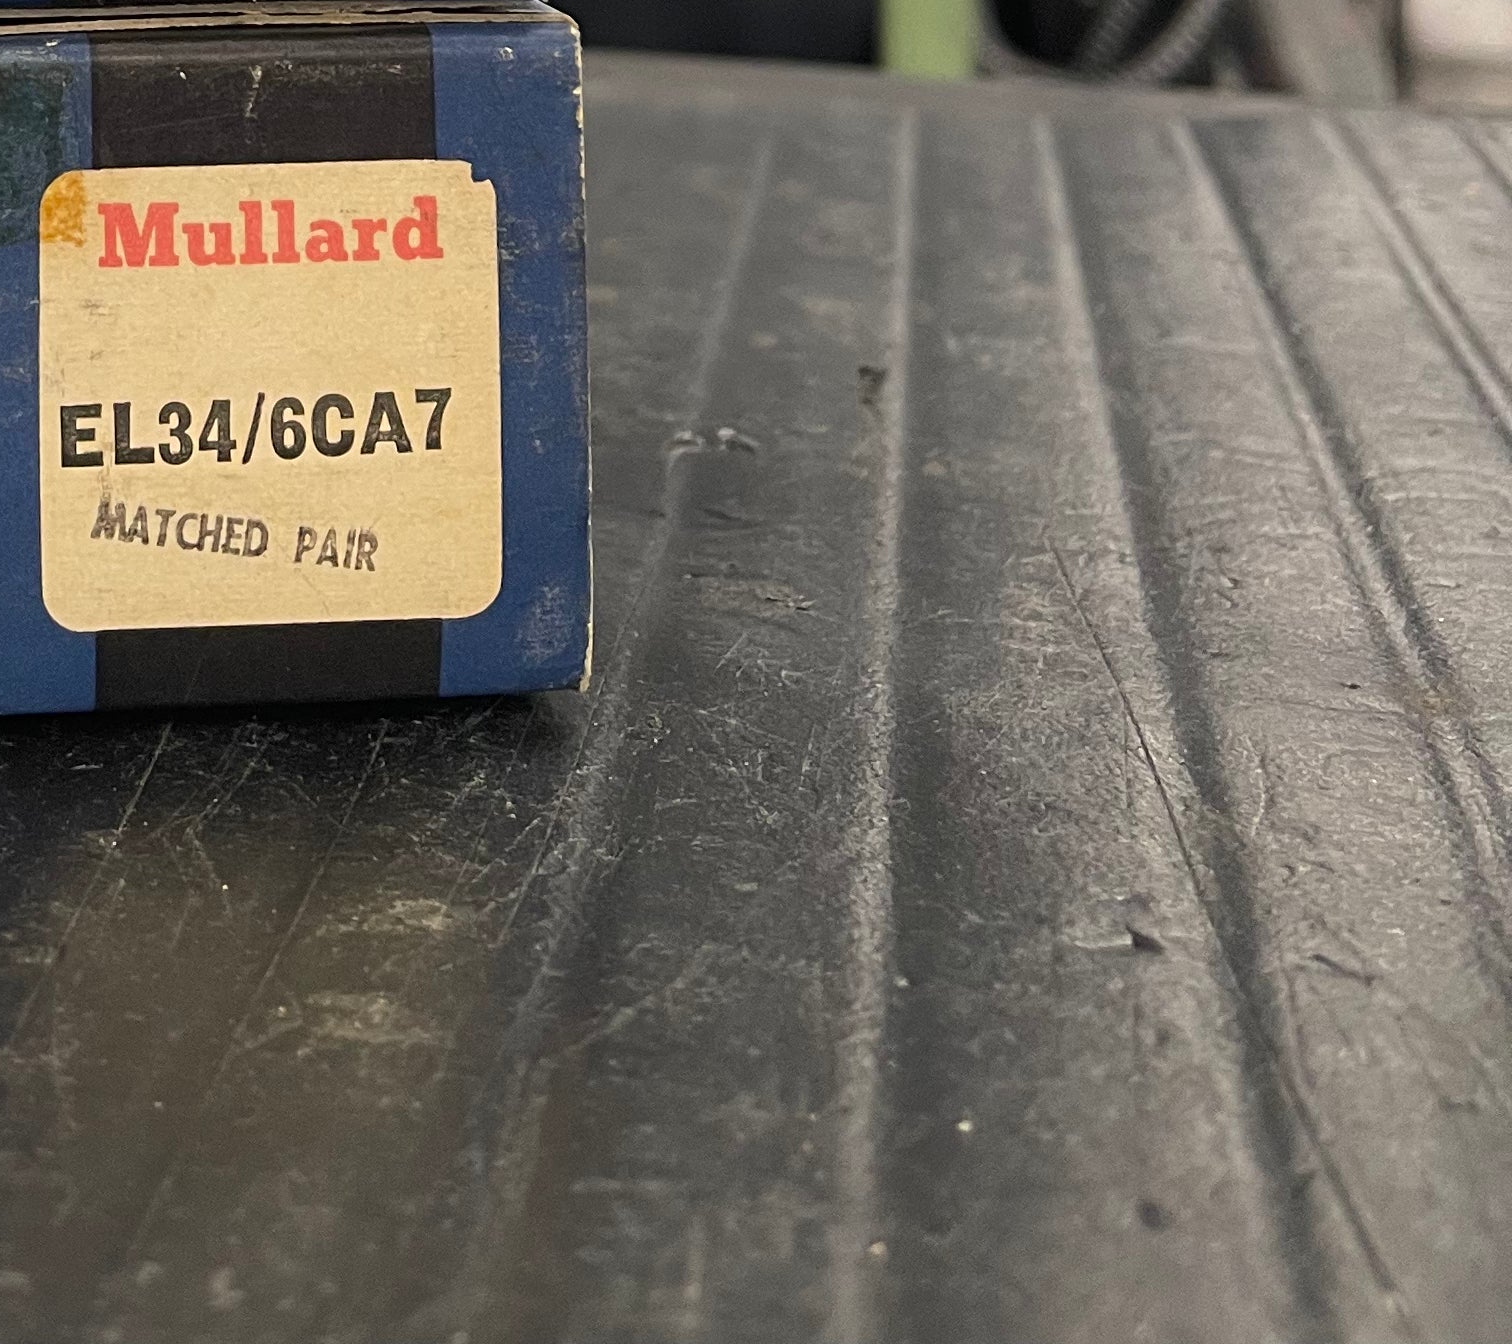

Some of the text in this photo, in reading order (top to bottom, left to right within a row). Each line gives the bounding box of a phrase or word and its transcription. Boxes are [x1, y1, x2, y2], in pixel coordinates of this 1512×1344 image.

[96, 194, 445, 269] Mullard
[59, 387, 453, 468] EL34/6CA7
[90, 498, 380, 573] MATCHED PAIR
